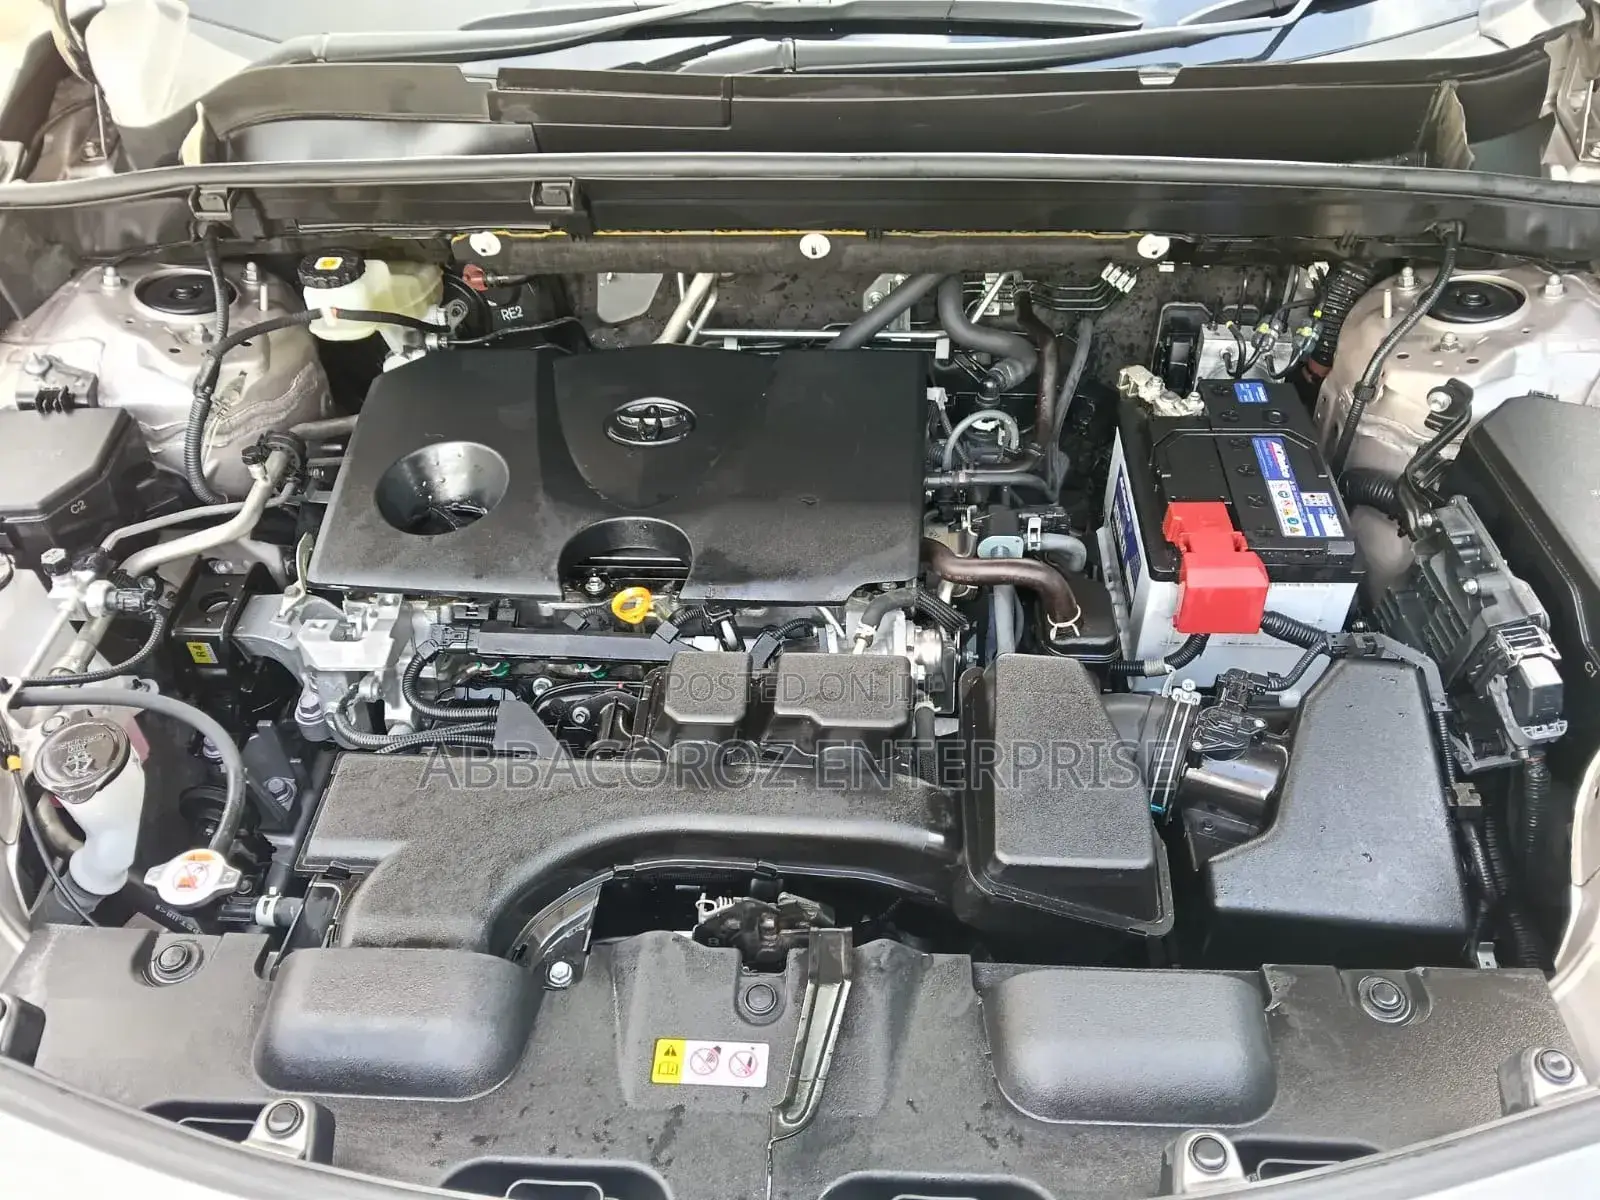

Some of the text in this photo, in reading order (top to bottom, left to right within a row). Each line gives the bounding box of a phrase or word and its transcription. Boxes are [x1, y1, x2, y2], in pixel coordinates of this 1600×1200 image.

[500, 305, 524, 320] RE2
[70, 500, 87, 514] C2
[1584, 661, 1598, 678] C1
